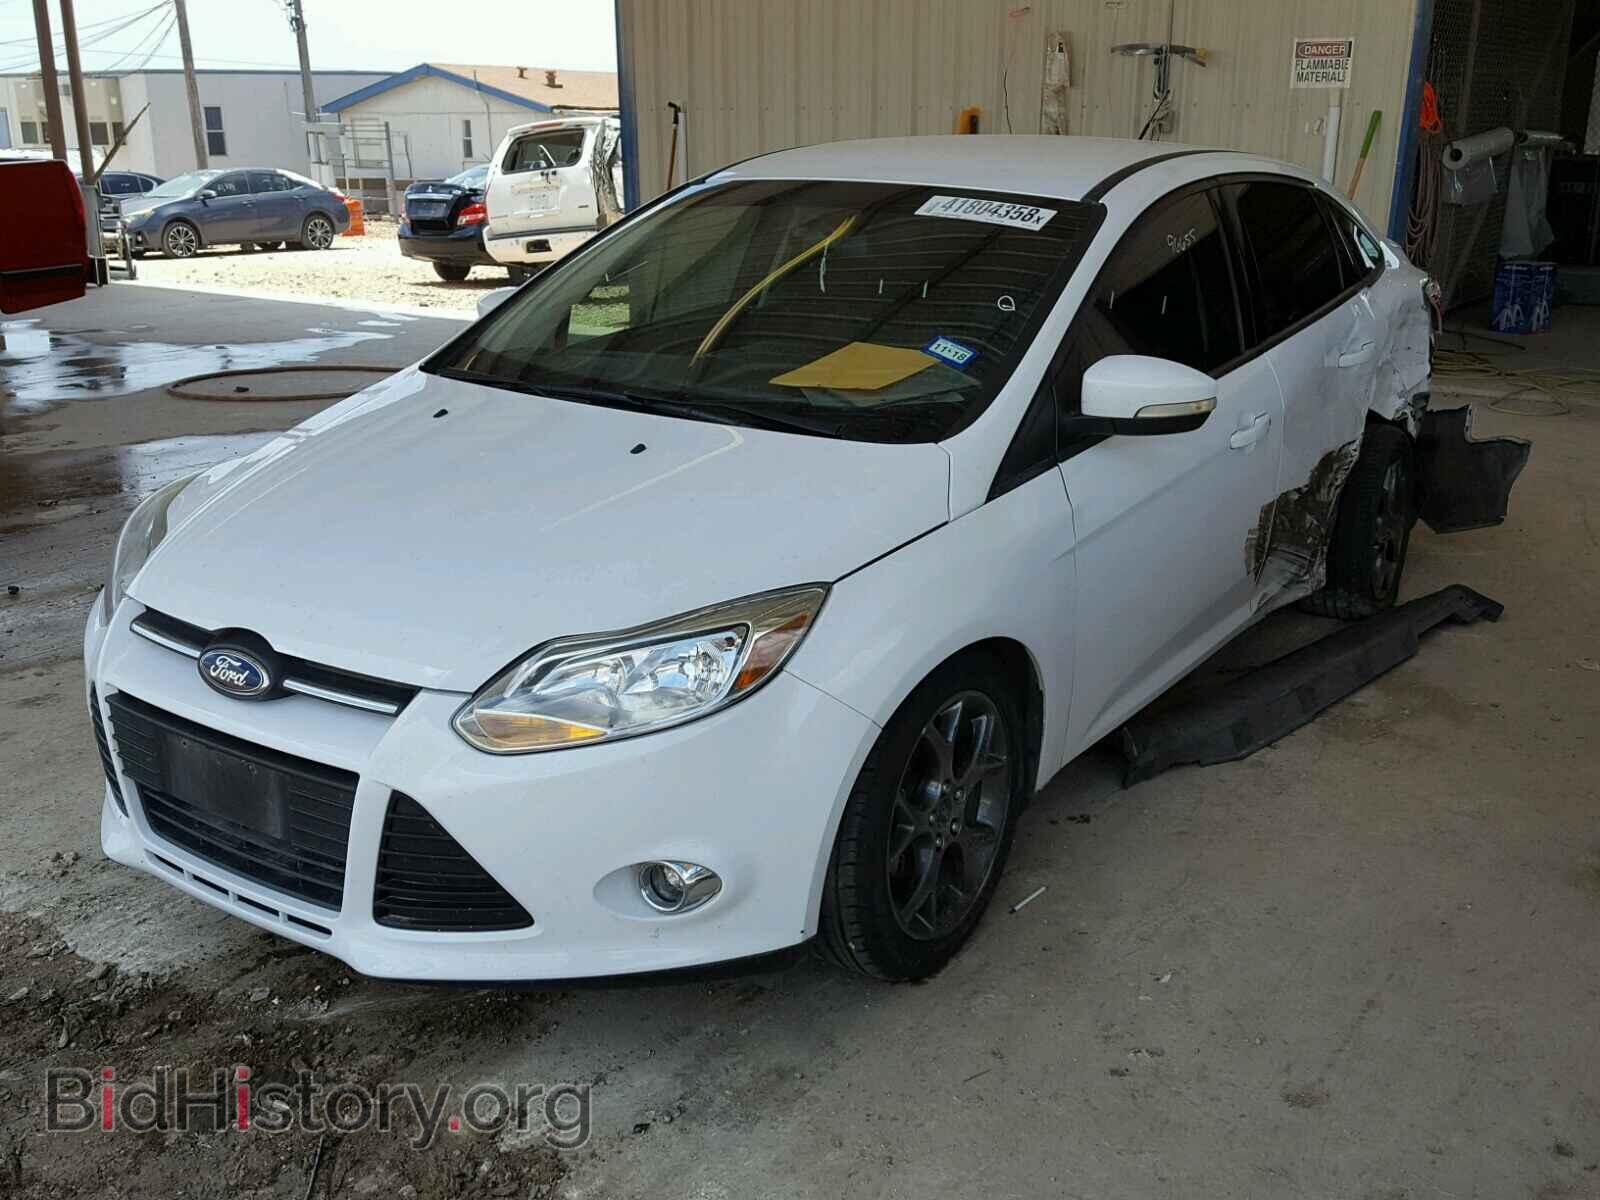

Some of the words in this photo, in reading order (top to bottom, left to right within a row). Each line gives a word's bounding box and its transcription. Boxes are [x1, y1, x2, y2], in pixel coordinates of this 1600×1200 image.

[1304, 45, 1347, 54] DANGER
[1296, 59, 1350, 70] FLAMMABLE
[209, 655, 250, 686] Ford
